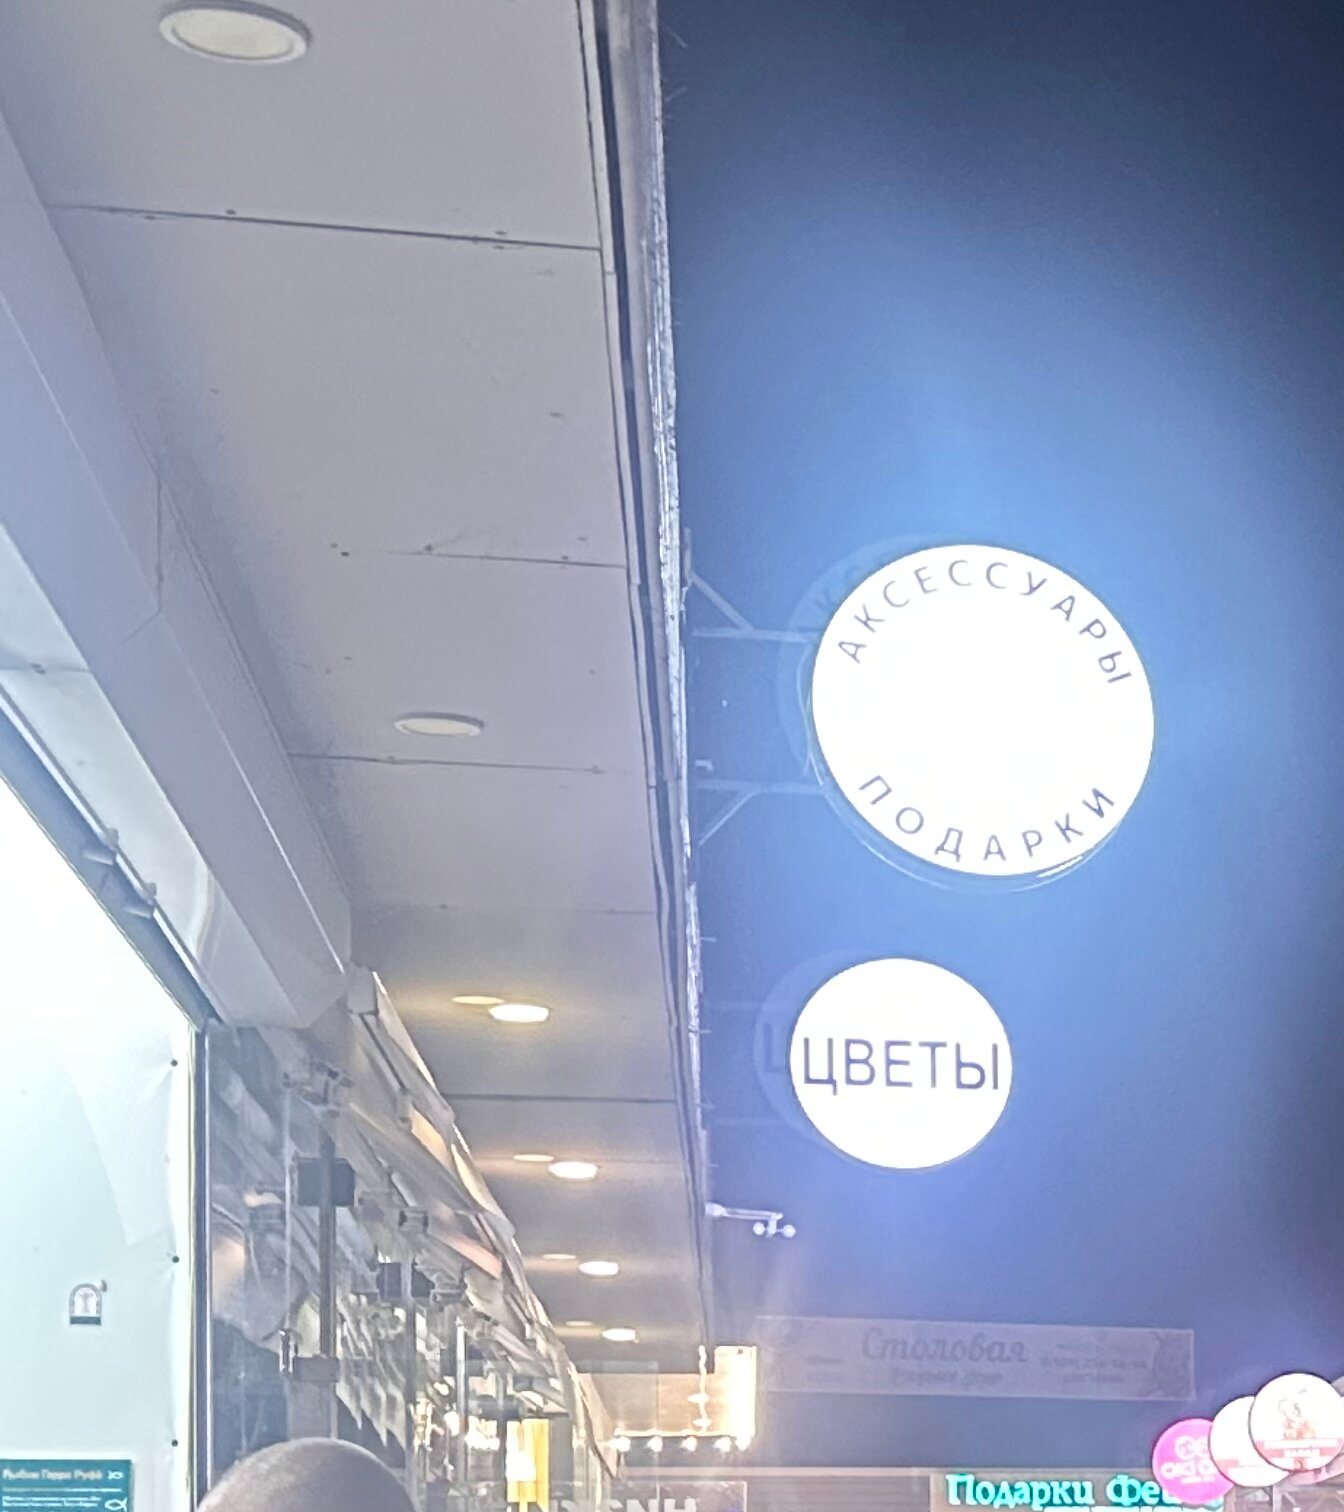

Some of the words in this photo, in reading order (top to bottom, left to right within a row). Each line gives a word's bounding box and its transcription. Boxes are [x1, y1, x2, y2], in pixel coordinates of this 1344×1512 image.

[837, 559, 1132, 685] АКСЕССУАРЫ
[857, 773, 1116, 863] ПОДАРКИ
[802, 1036, 1002, 1096] ЦВЕТЫ
[945, 1473, 1095, 1511] Подарки
